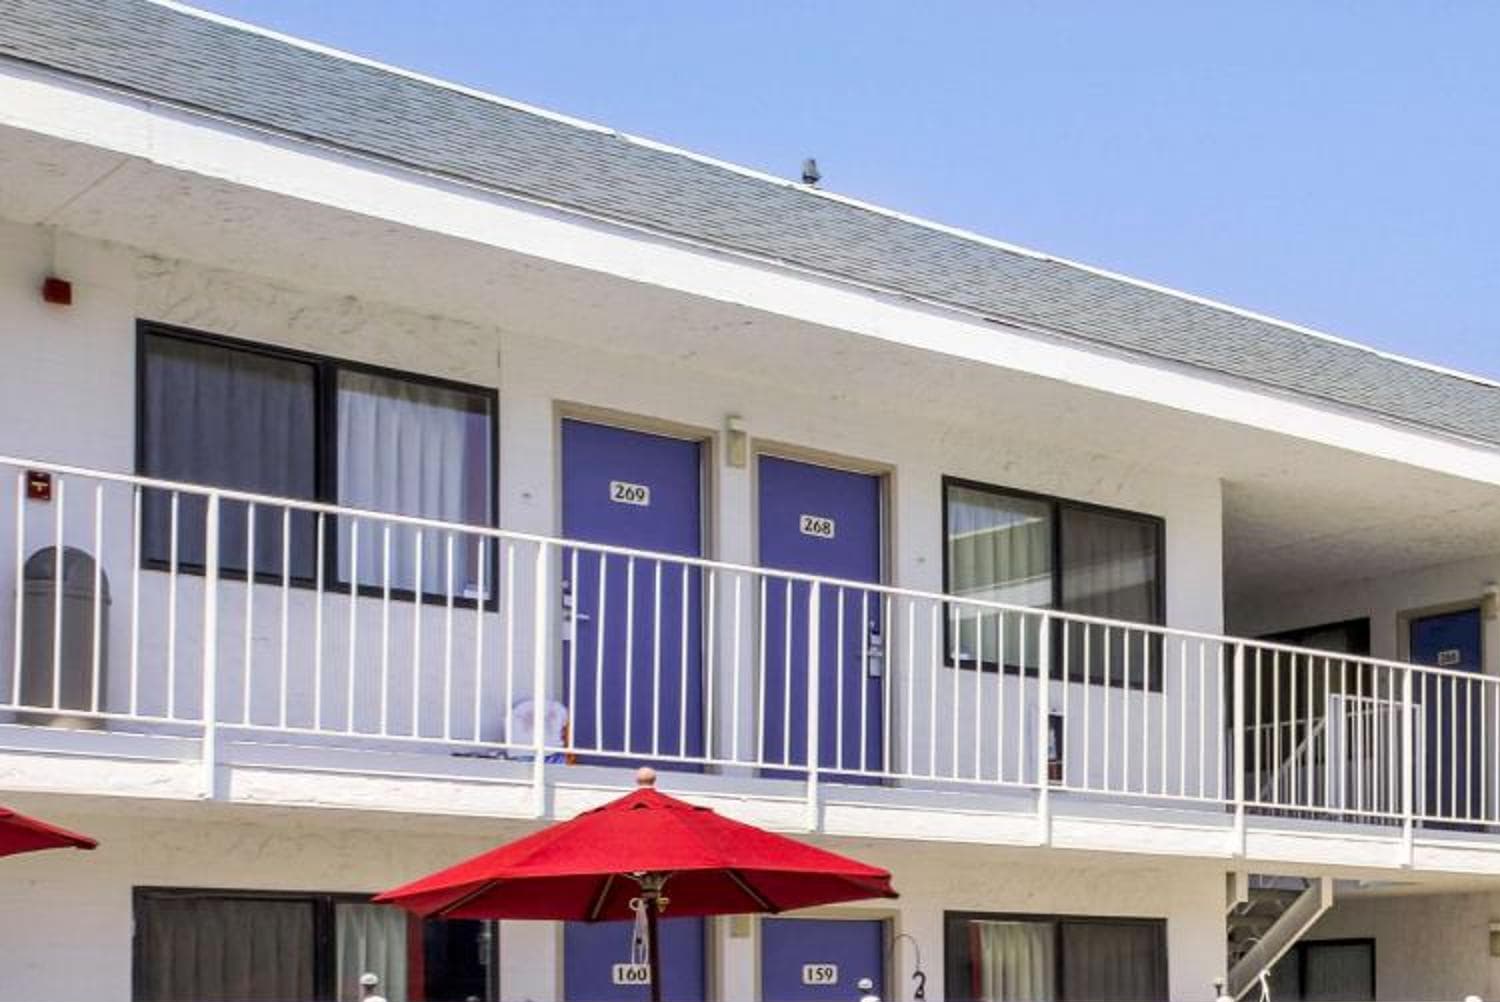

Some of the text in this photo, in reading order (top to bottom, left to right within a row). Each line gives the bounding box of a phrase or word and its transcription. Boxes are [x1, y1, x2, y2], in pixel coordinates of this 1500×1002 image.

[614, 484, 646, 501] 269
[803, 518, 831, 535] 268
[616, 967, 648, 982] 160
[807, 968, 833, 982] 159
